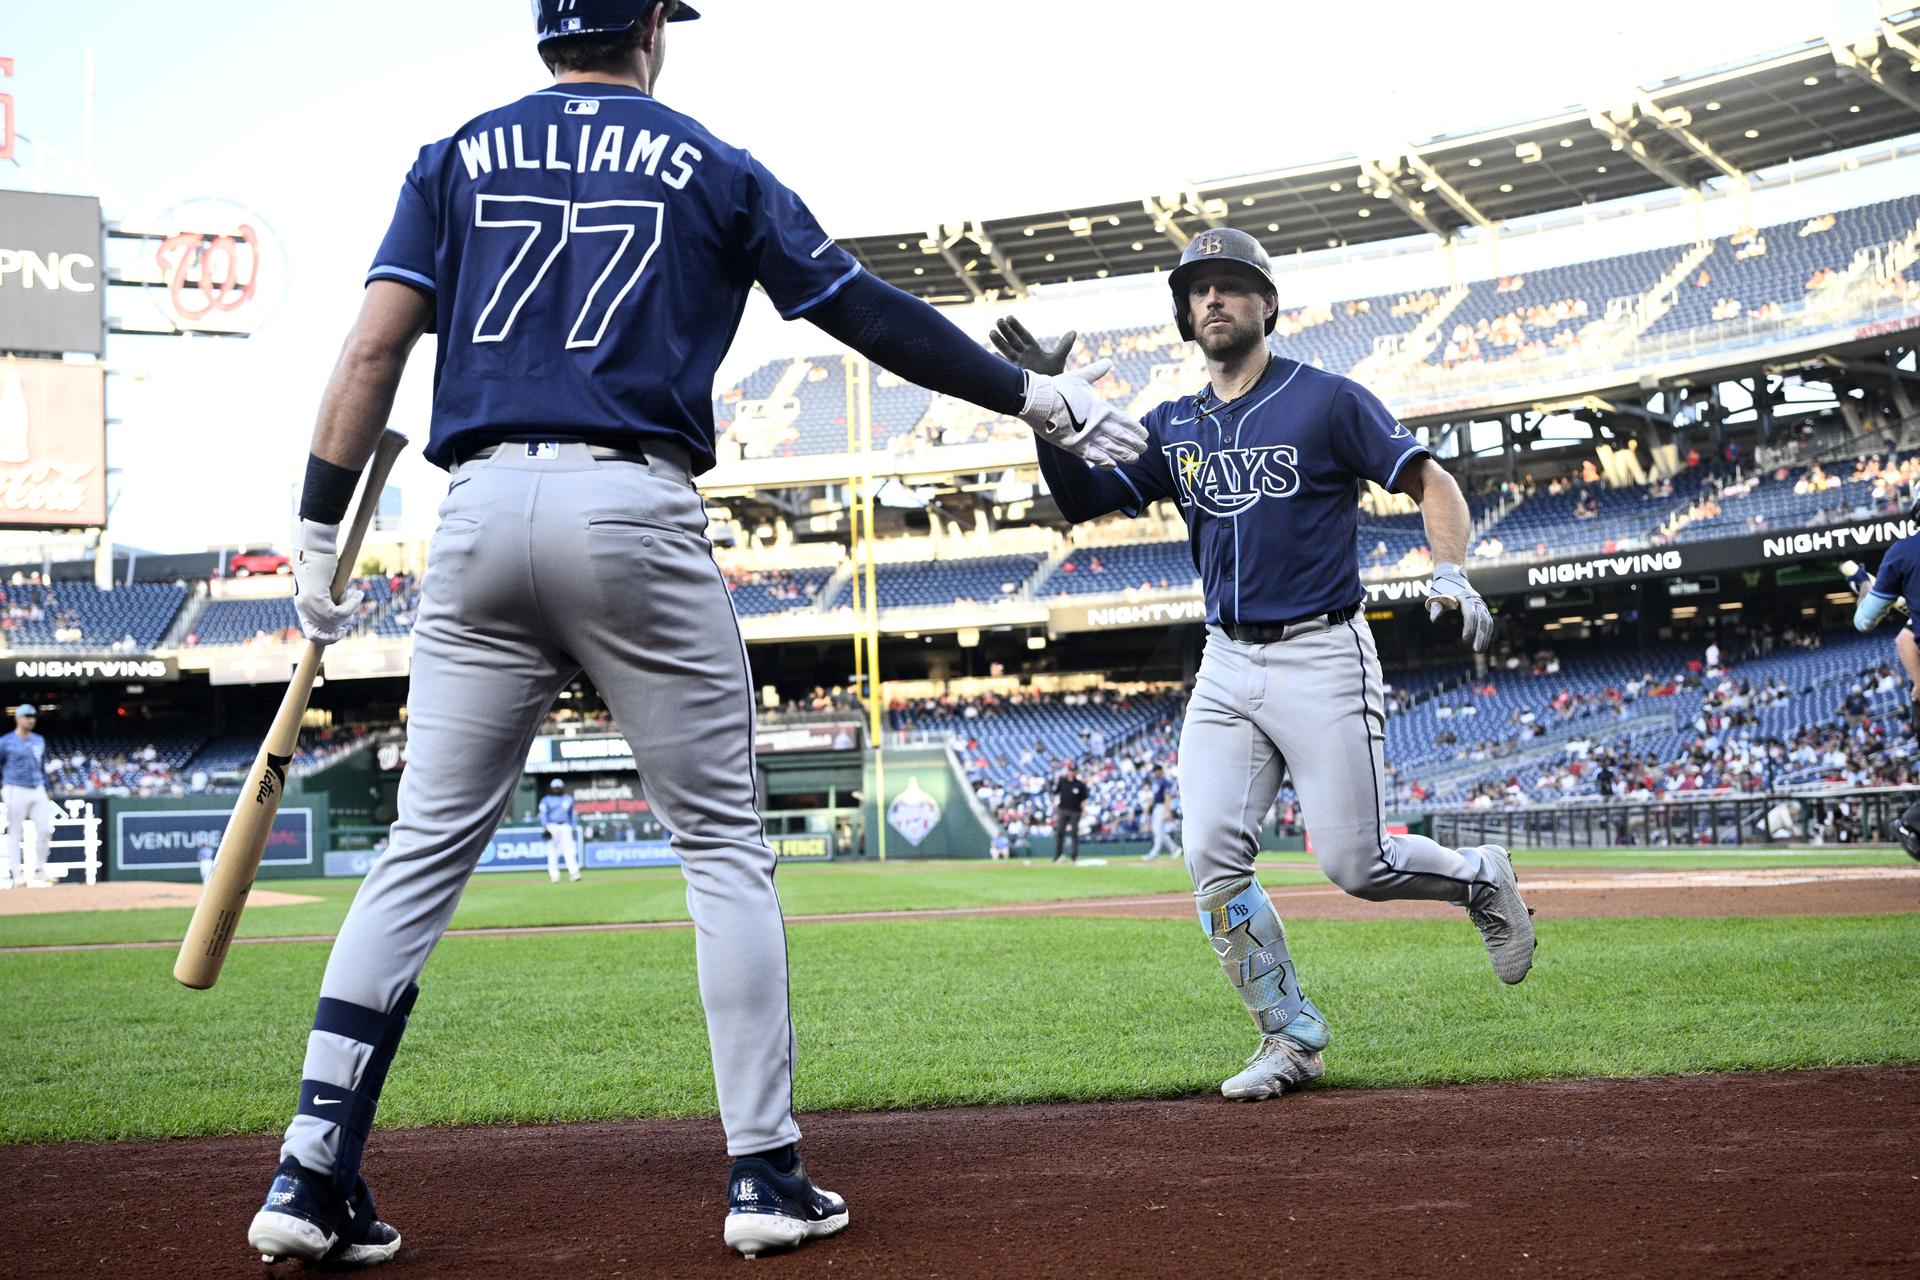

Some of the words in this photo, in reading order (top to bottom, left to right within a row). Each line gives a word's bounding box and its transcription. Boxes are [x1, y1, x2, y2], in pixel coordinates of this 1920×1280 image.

[458, 124, 702, 190] WILLIAMS
[0, 249, 95, 292] PNC
[472, 194, 665, 350] 77
[0, 462, 97, 512] Cola
[1162, 440, 1300, 517] RAYS
[1528, 550, 1682, 586] NIGHTWING
[1087, 600, 1207, 625] NIGHTWIN
[15, 661, 166, 677] NIGHTWING
[256, 752, 293, 805] Victus
[129, 829, 223, 850] VENTURE
[1230, 903, 1249, 917] TB
[1256, 951, 1275, 966] TB
[1269, 1007, 1288, 1022] TB
